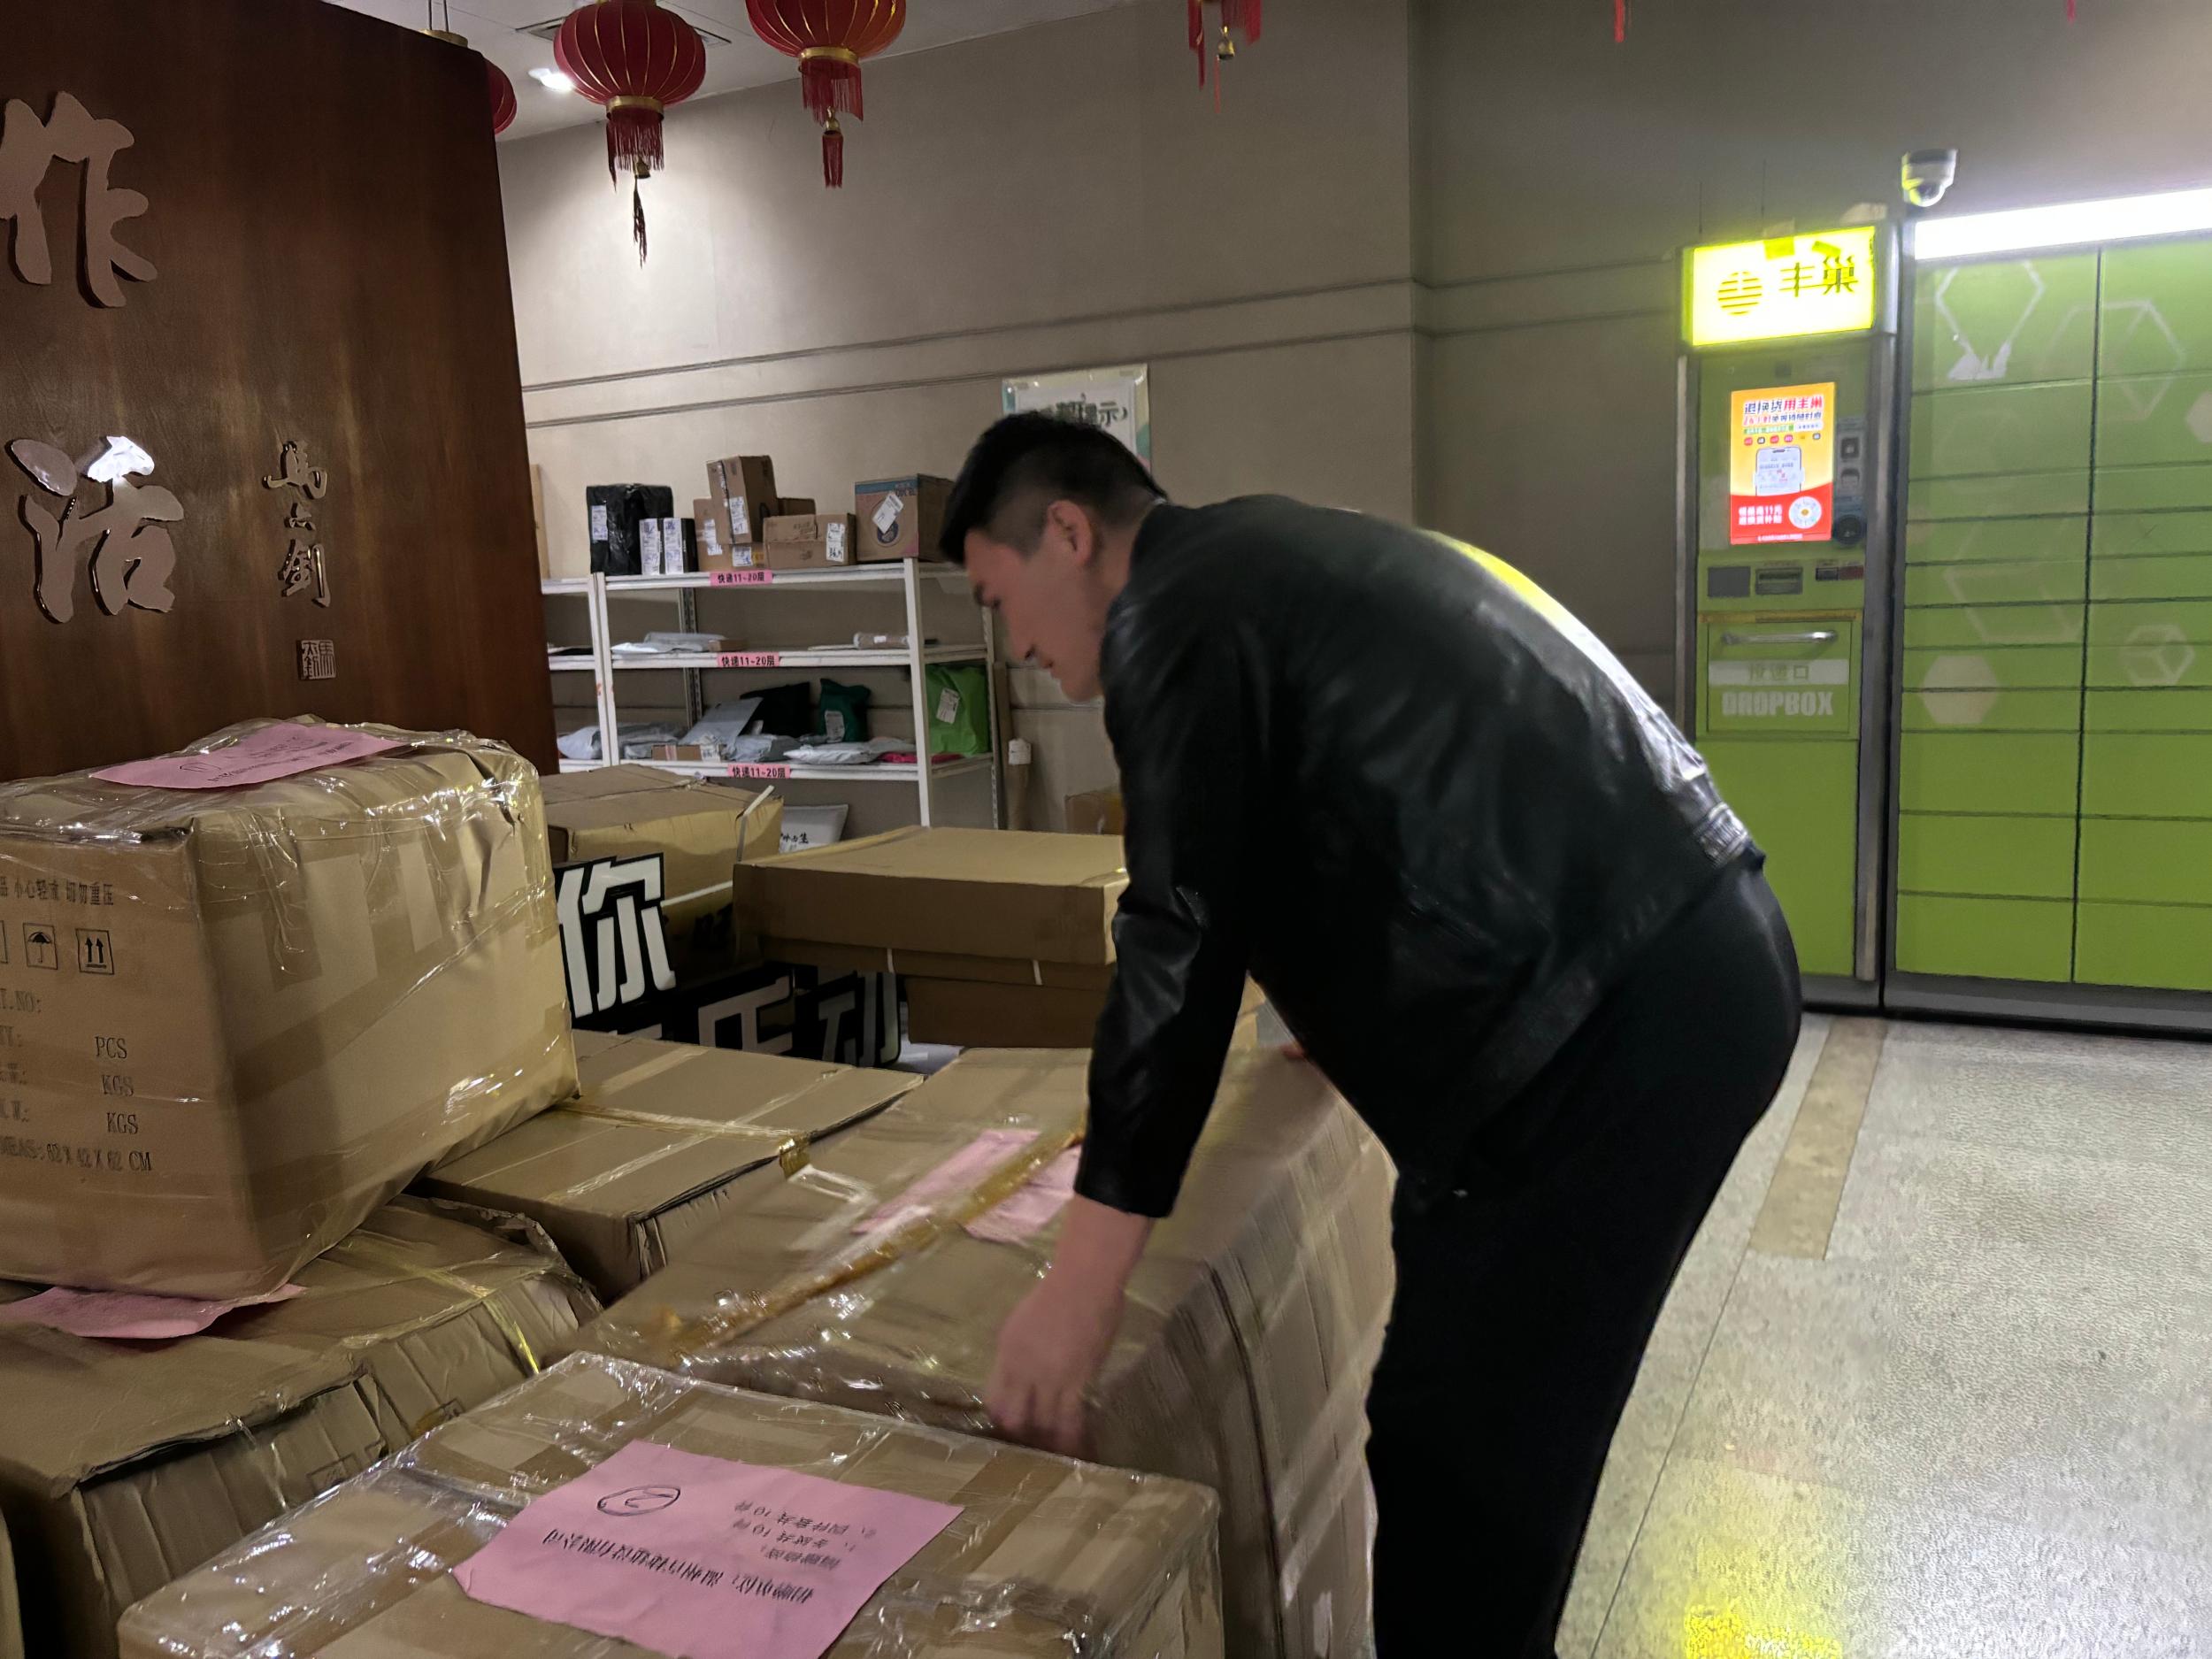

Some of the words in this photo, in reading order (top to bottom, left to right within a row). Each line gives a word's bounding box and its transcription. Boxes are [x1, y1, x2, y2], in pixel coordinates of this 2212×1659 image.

[1778, 255, 1858, 297] 丰巢
[12, 435, 184, 624] 活
[1722, 691, 1833, 717] DROPBOX
[557, 856, 676, 1018] 你
[95, 1036, 127, 1059] PCS
[101, 1074, 134, 1096] KGS
[106, 1112, 138, 1134] KGS
[129, 1150, 152, 1171] CM
